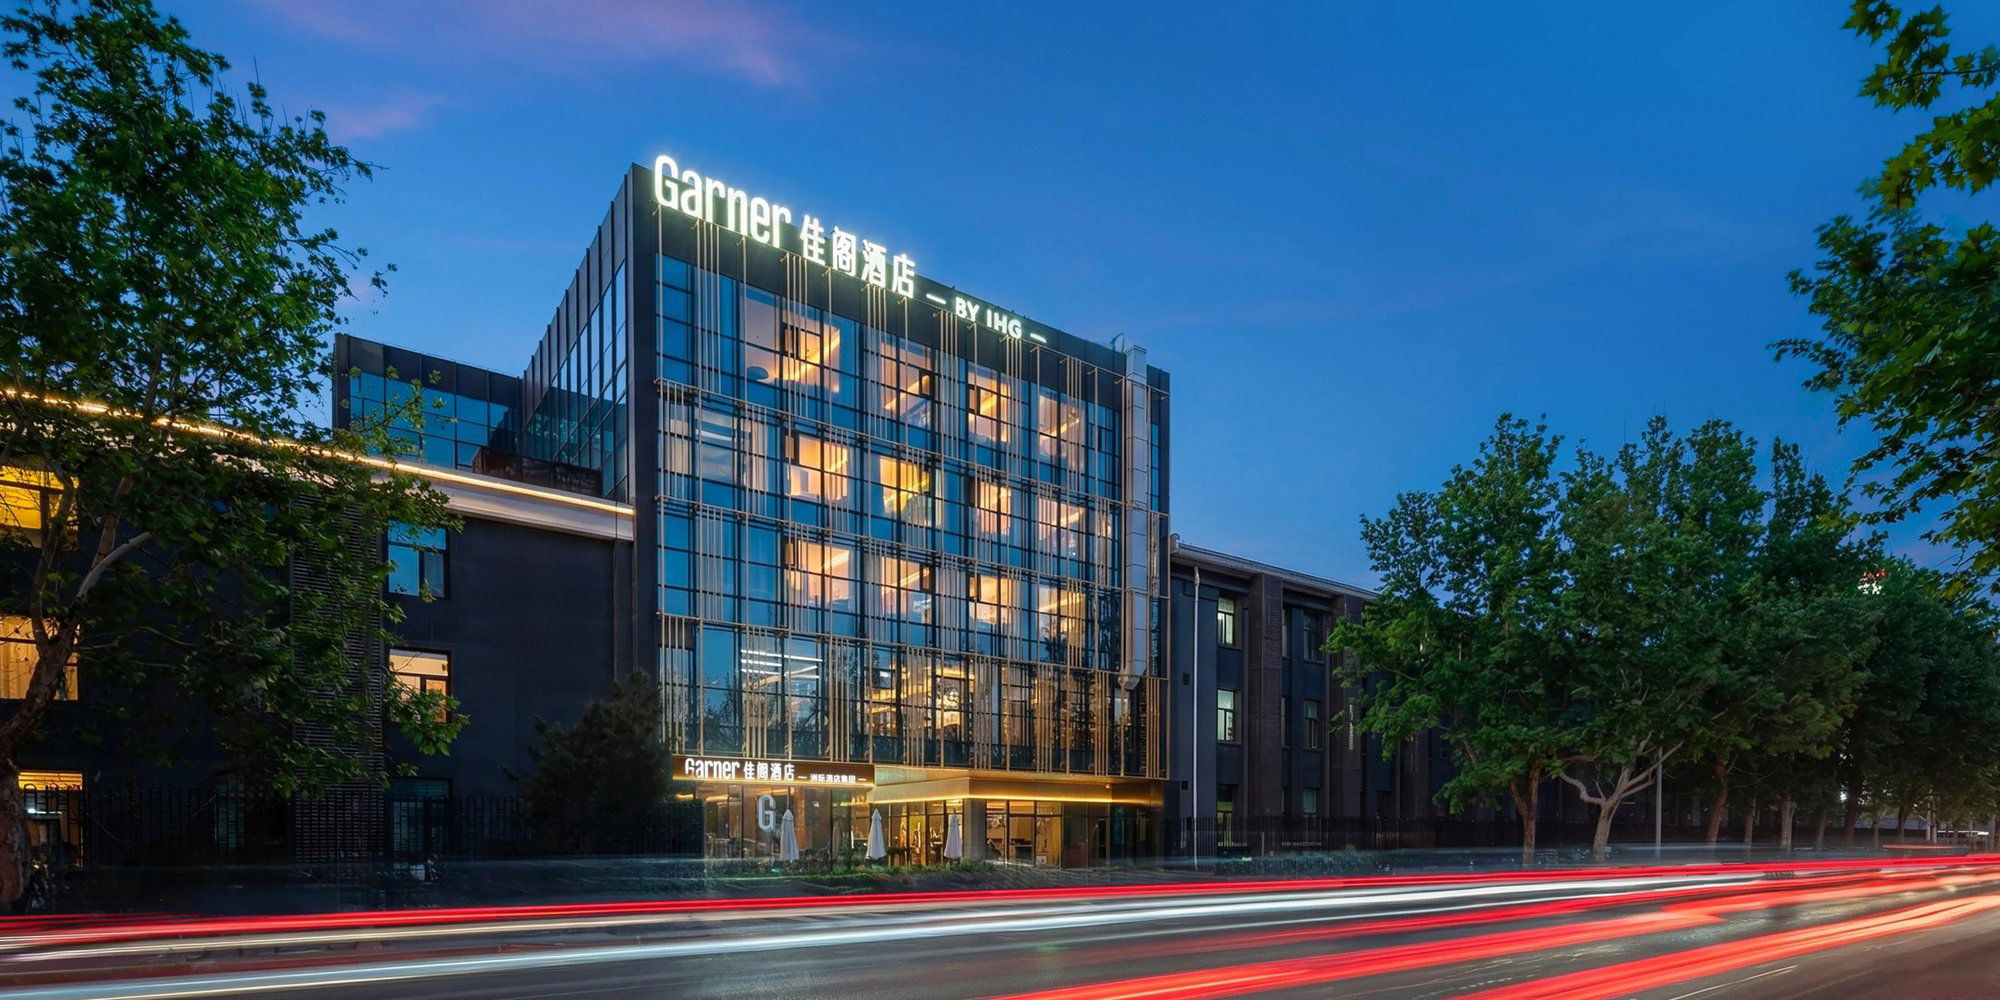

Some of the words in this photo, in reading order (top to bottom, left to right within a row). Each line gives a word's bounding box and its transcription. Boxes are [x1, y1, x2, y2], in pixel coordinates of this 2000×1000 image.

[654, 155, 791, 248] Garner
[799, 213, 915, 299] 佳阁酒店
[955, 297, 979, 322] BY
[986, 309, 1022, 339] IHG
[685, 758, 740, 779] Garner
[743, 761, 795, 780] 佳阁酒店
[758, 793, 776, 832] G
